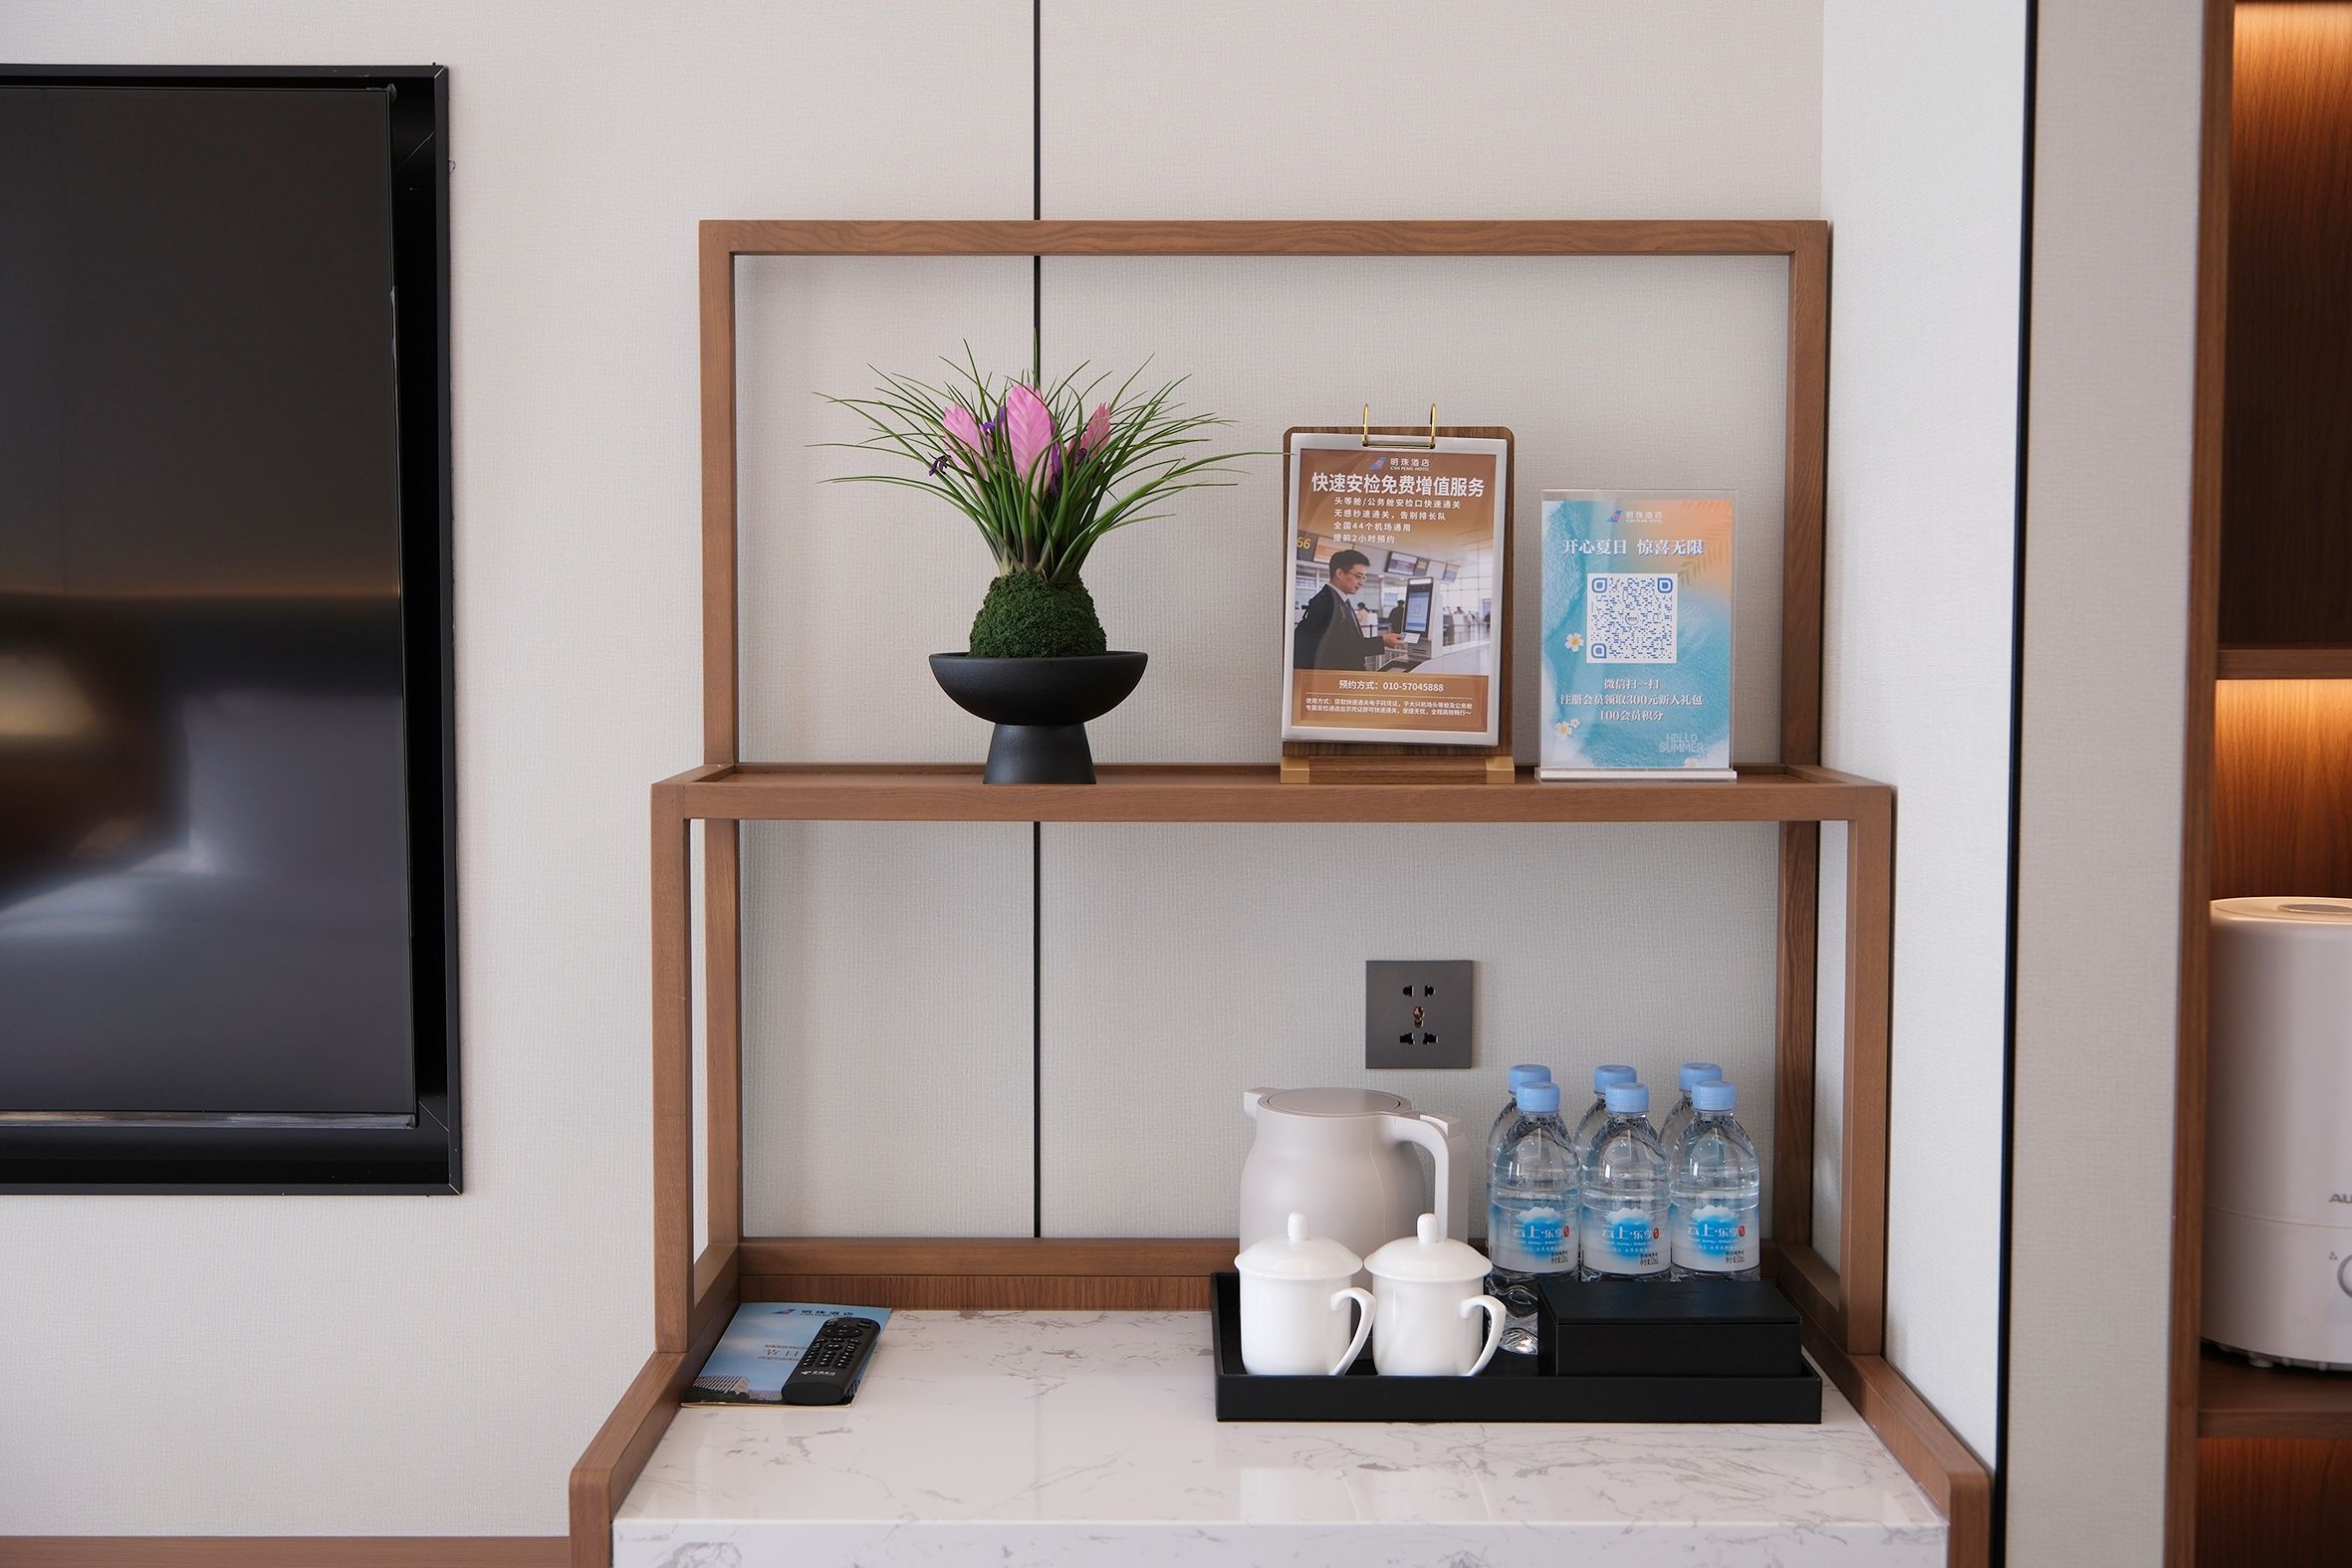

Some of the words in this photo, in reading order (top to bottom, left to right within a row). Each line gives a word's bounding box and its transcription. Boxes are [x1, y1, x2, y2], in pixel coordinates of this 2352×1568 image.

[1390, 457, 1430, 467] 明珠酒店
[1311, 472, 1485, 497] 快速安检免费增值服务
[1334, 497, 1461, 509] 头等舱/公务舱安检口快速通关
[1333, 521, 1411, 533] 全国44个机场通用
[1333, 534, 1395, 544] 提前2小时预约
[1563, 540, 1628, 556] 开心夏日
[1637, 540, 1706, 556] 惊喜无限
[1603, 678, 1660, 690] 微信扫一扫
[1560, 694, 1703, 706] 注册会员领取300元新人礼包
[1600, 711, 1663, 722] 100会员积分
[1666, 733, 1698, 743] HELLO
[1659, 742, 1705, 754] SUMMER
